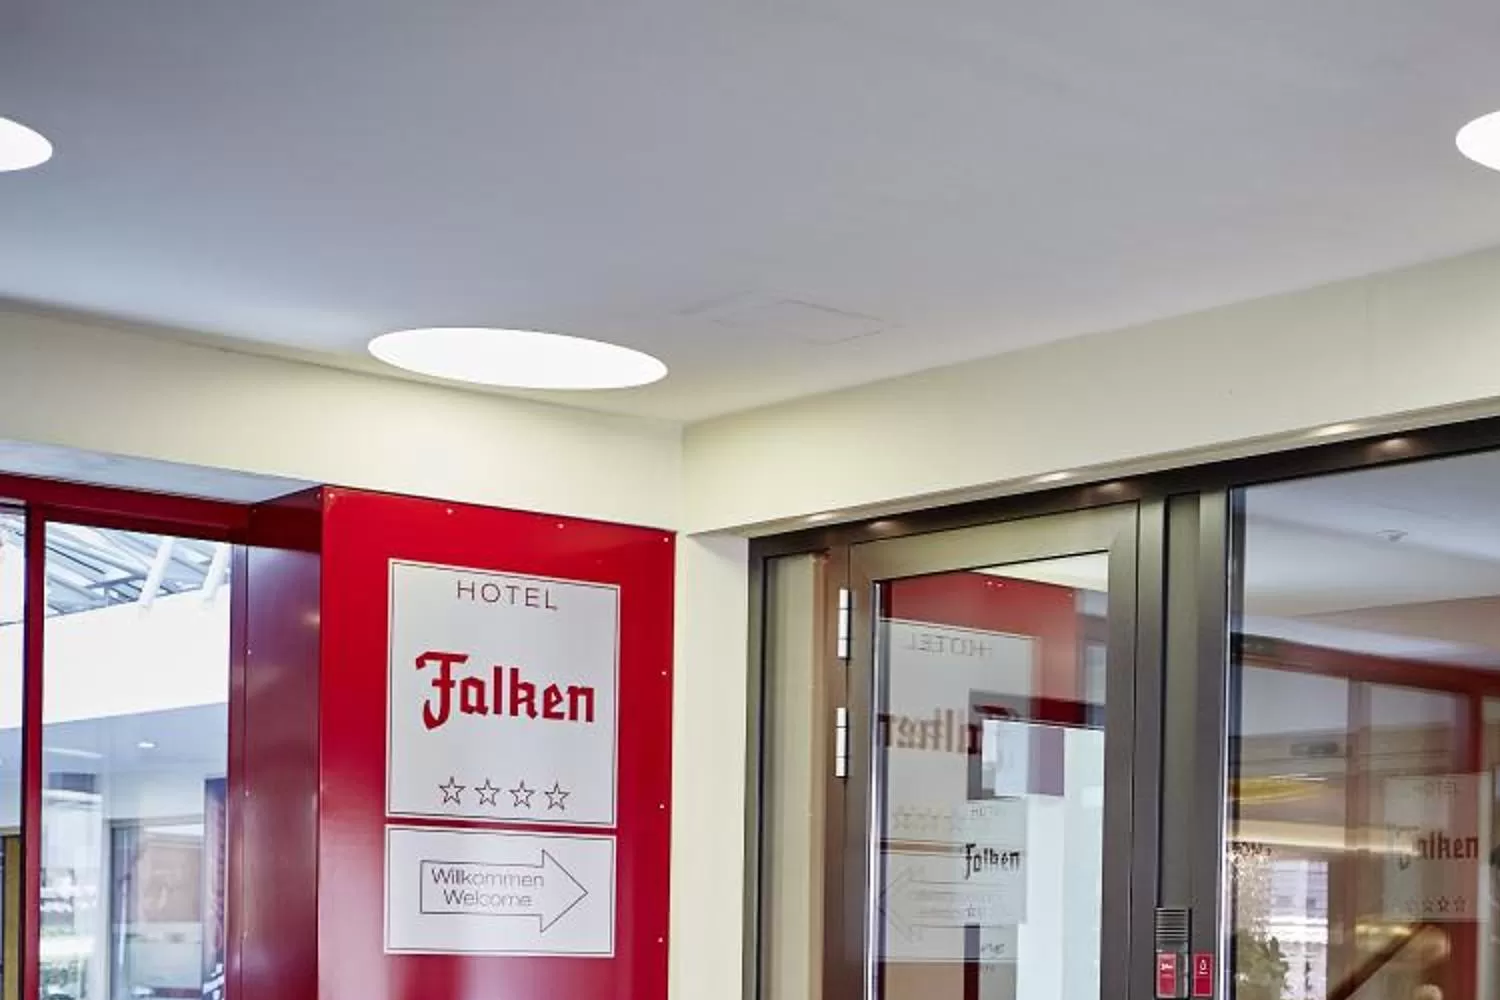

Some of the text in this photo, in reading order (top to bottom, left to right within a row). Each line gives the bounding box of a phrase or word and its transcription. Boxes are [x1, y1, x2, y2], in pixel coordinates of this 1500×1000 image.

[456, 579, 559, 611] HOTEL
[415, 650, 596, 731] Falken
[430, 867, 545, 889] Willkommen
[443, 888, 533, 907] Welcome
